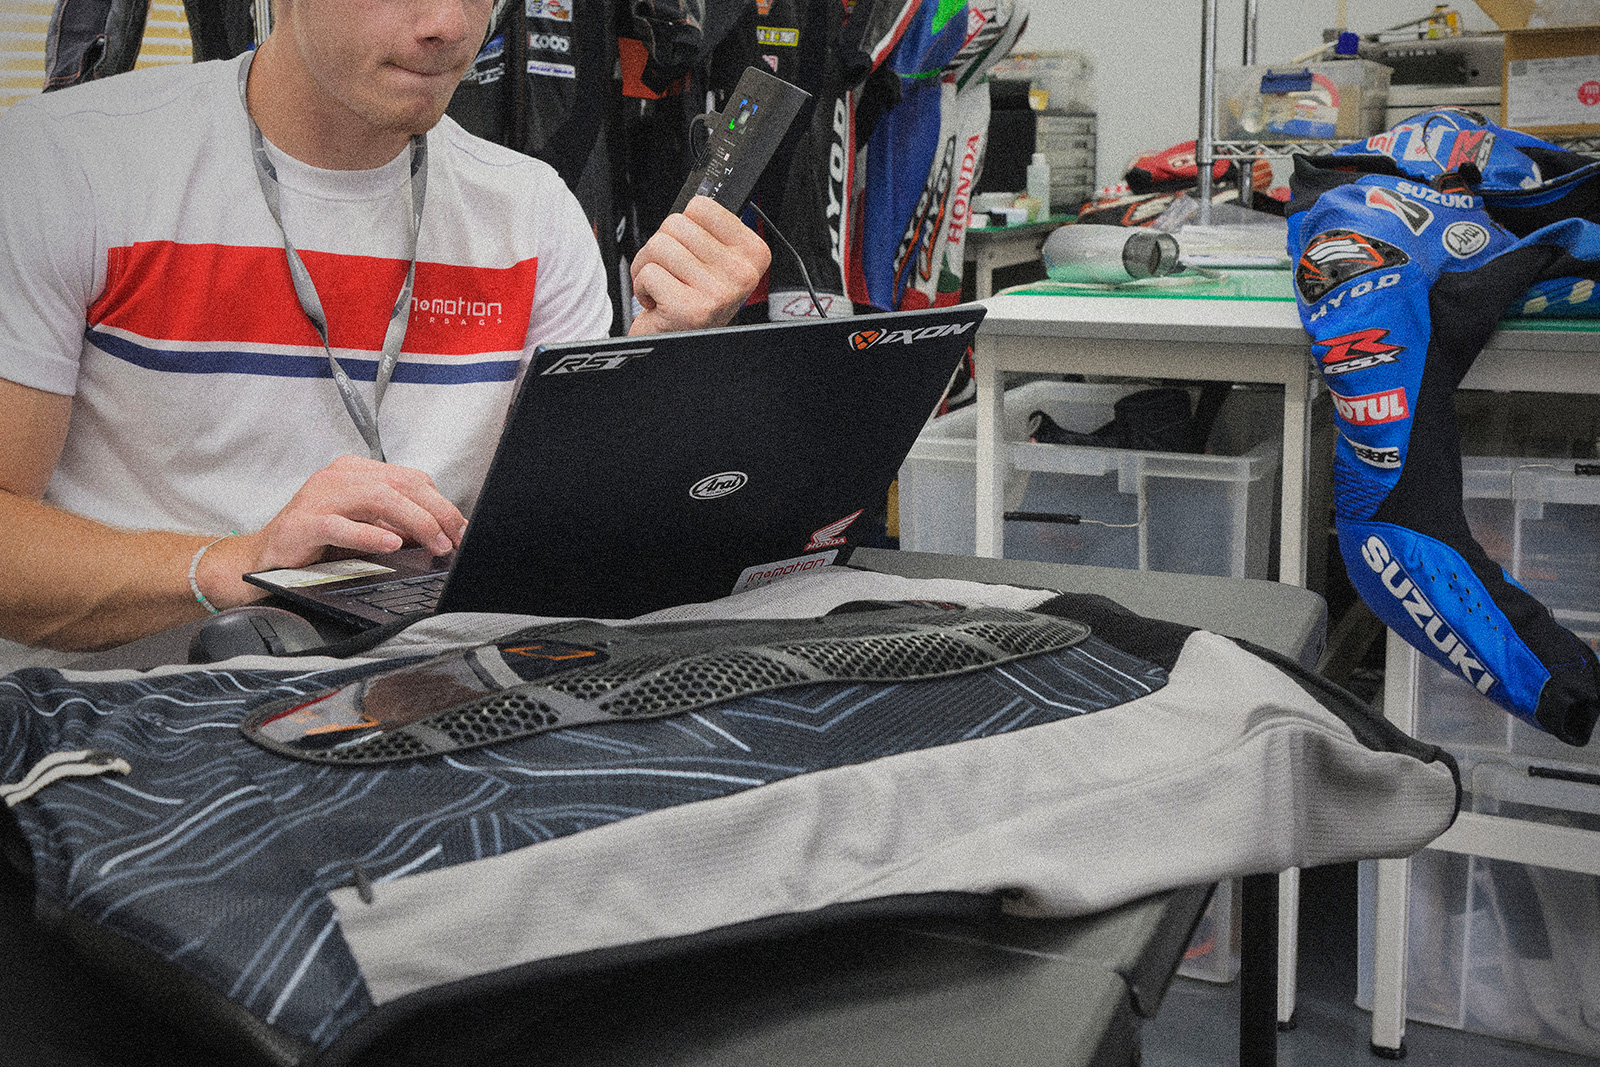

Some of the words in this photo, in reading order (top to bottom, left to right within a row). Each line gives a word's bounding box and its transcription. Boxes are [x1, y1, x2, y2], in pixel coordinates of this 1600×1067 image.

[947, 134, 980, 246] HONDA
[1395, 181, 1474, 209] SUZUKI
[1309, 273, 1401, 322] HYOD
[415, 315, 502, 326] IRBAGS
[1323, 349, 1400, 375] GSX
[693, 474, 742, 494] Arai
[806, 537, 846, 550] HONDA
[1361, 535, 1495, 695] SUZUKI
